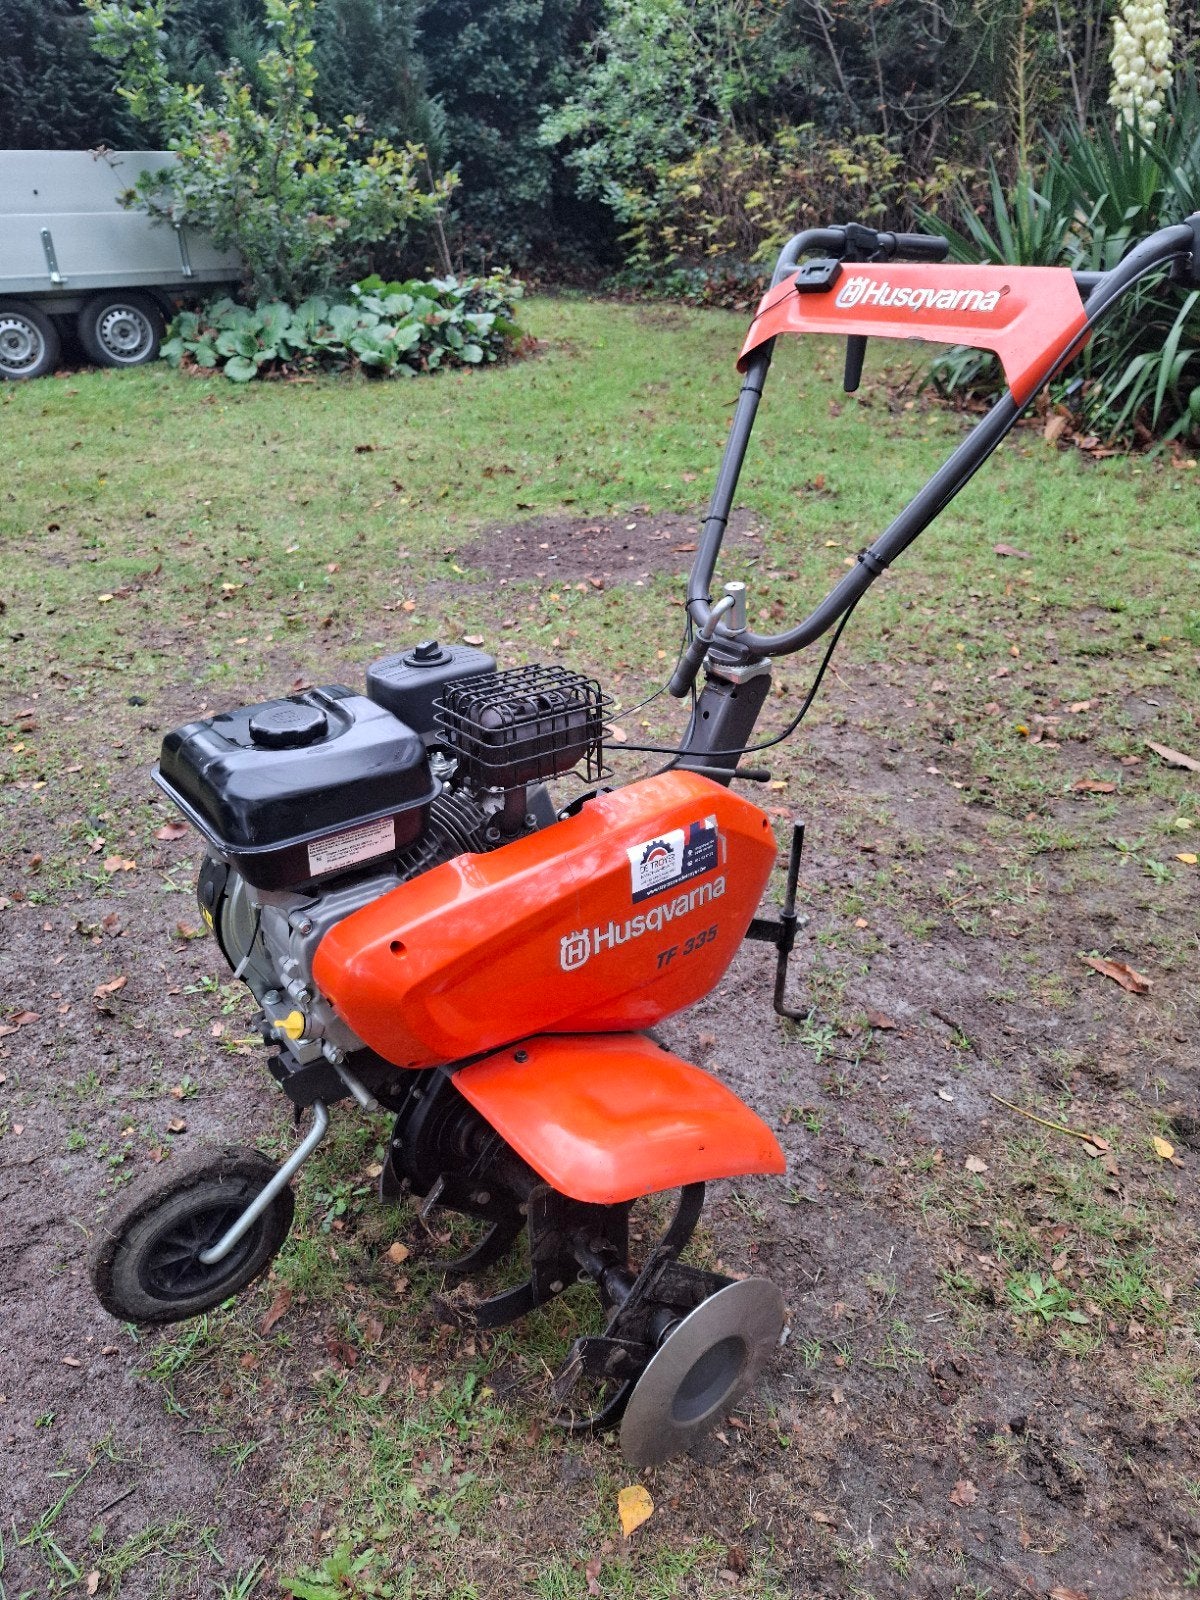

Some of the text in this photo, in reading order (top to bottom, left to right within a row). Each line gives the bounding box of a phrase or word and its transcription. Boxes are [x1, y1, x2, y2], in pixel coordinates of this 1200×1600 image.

[860, 280, 1001, 311] Husqvarna
[594, 875, 726, 955] Husqvarna
[657, 923, 718, 969] TF 335
